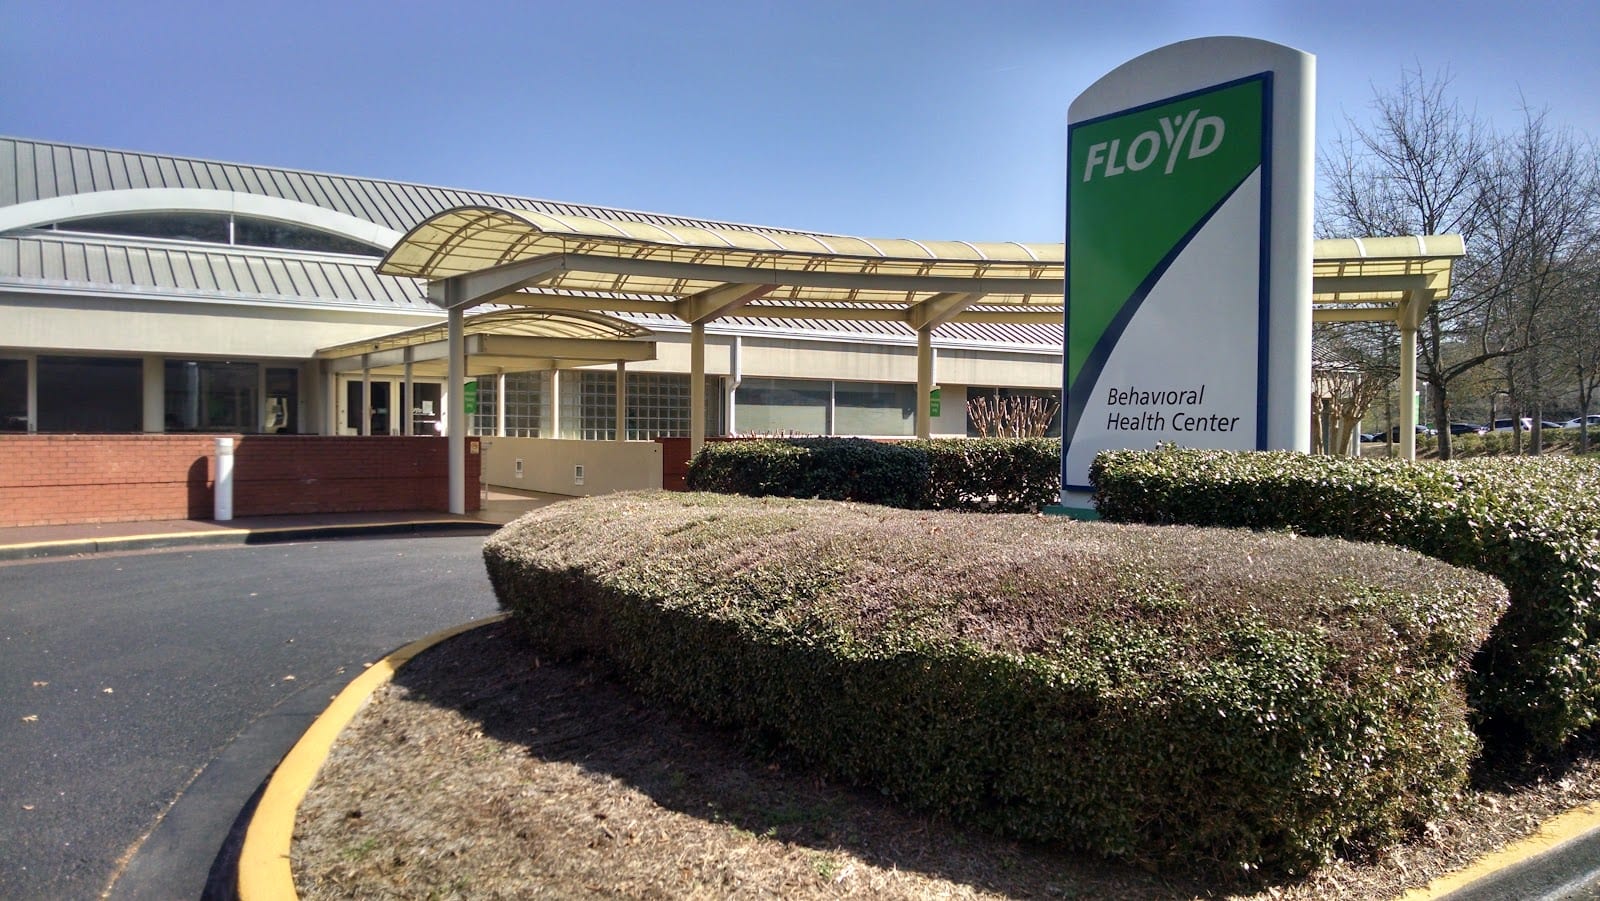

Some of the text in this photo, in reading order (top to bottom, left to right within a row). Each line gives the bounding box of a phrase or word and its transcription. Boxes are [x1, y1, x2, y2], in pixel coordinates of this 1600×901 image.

[1083, 108, 1226, 183] FLOYD
[1107, 384, 1205, 406] Behavioral
[1106, 411, 1240, 432] Health Center
